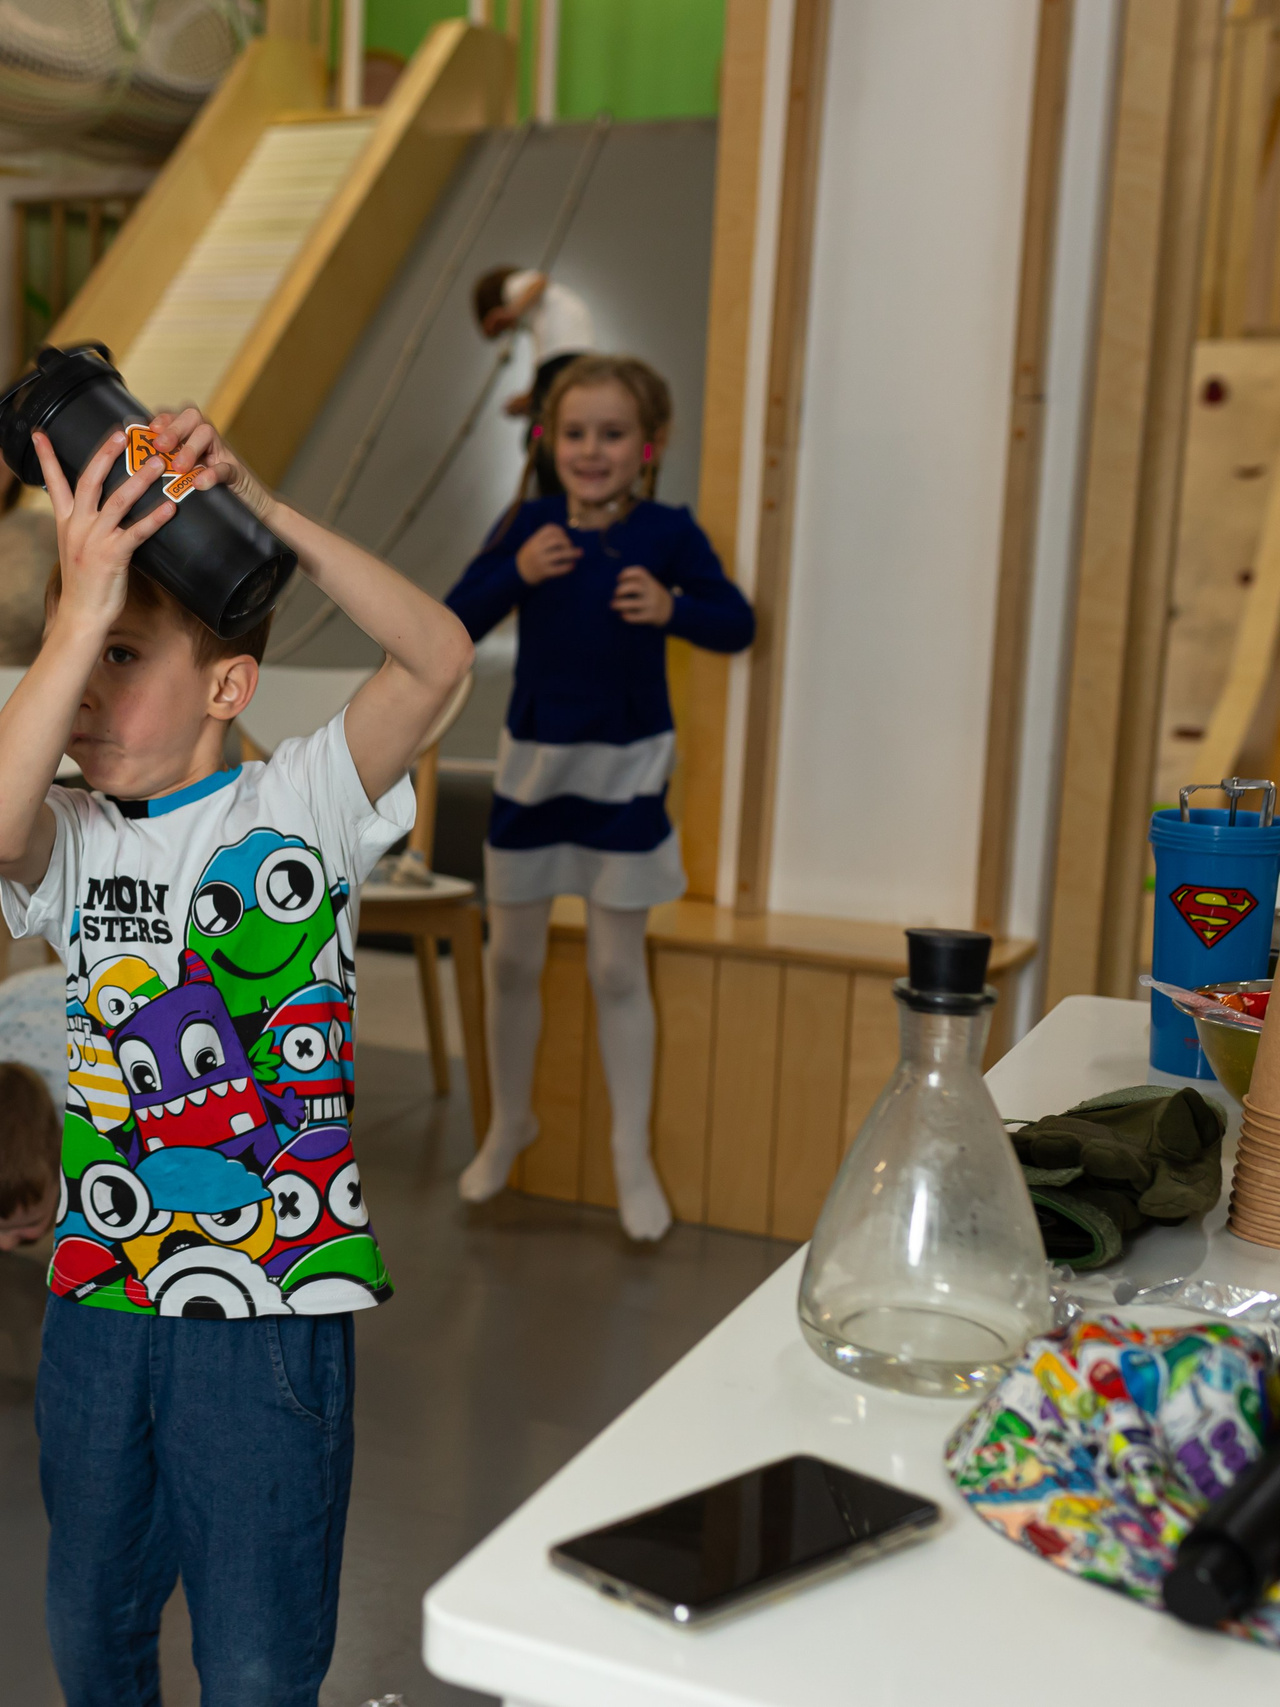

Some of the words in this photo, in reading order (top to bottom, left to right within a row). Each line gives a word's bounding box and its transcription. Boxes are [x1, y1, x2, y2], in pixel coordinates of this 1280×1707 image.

[172, 476, 194, 494] GOOD
[82, 875, 169, 916] MON
[1175, 885, 1254, 938] S
[82, 915, 173, 944] STERS
